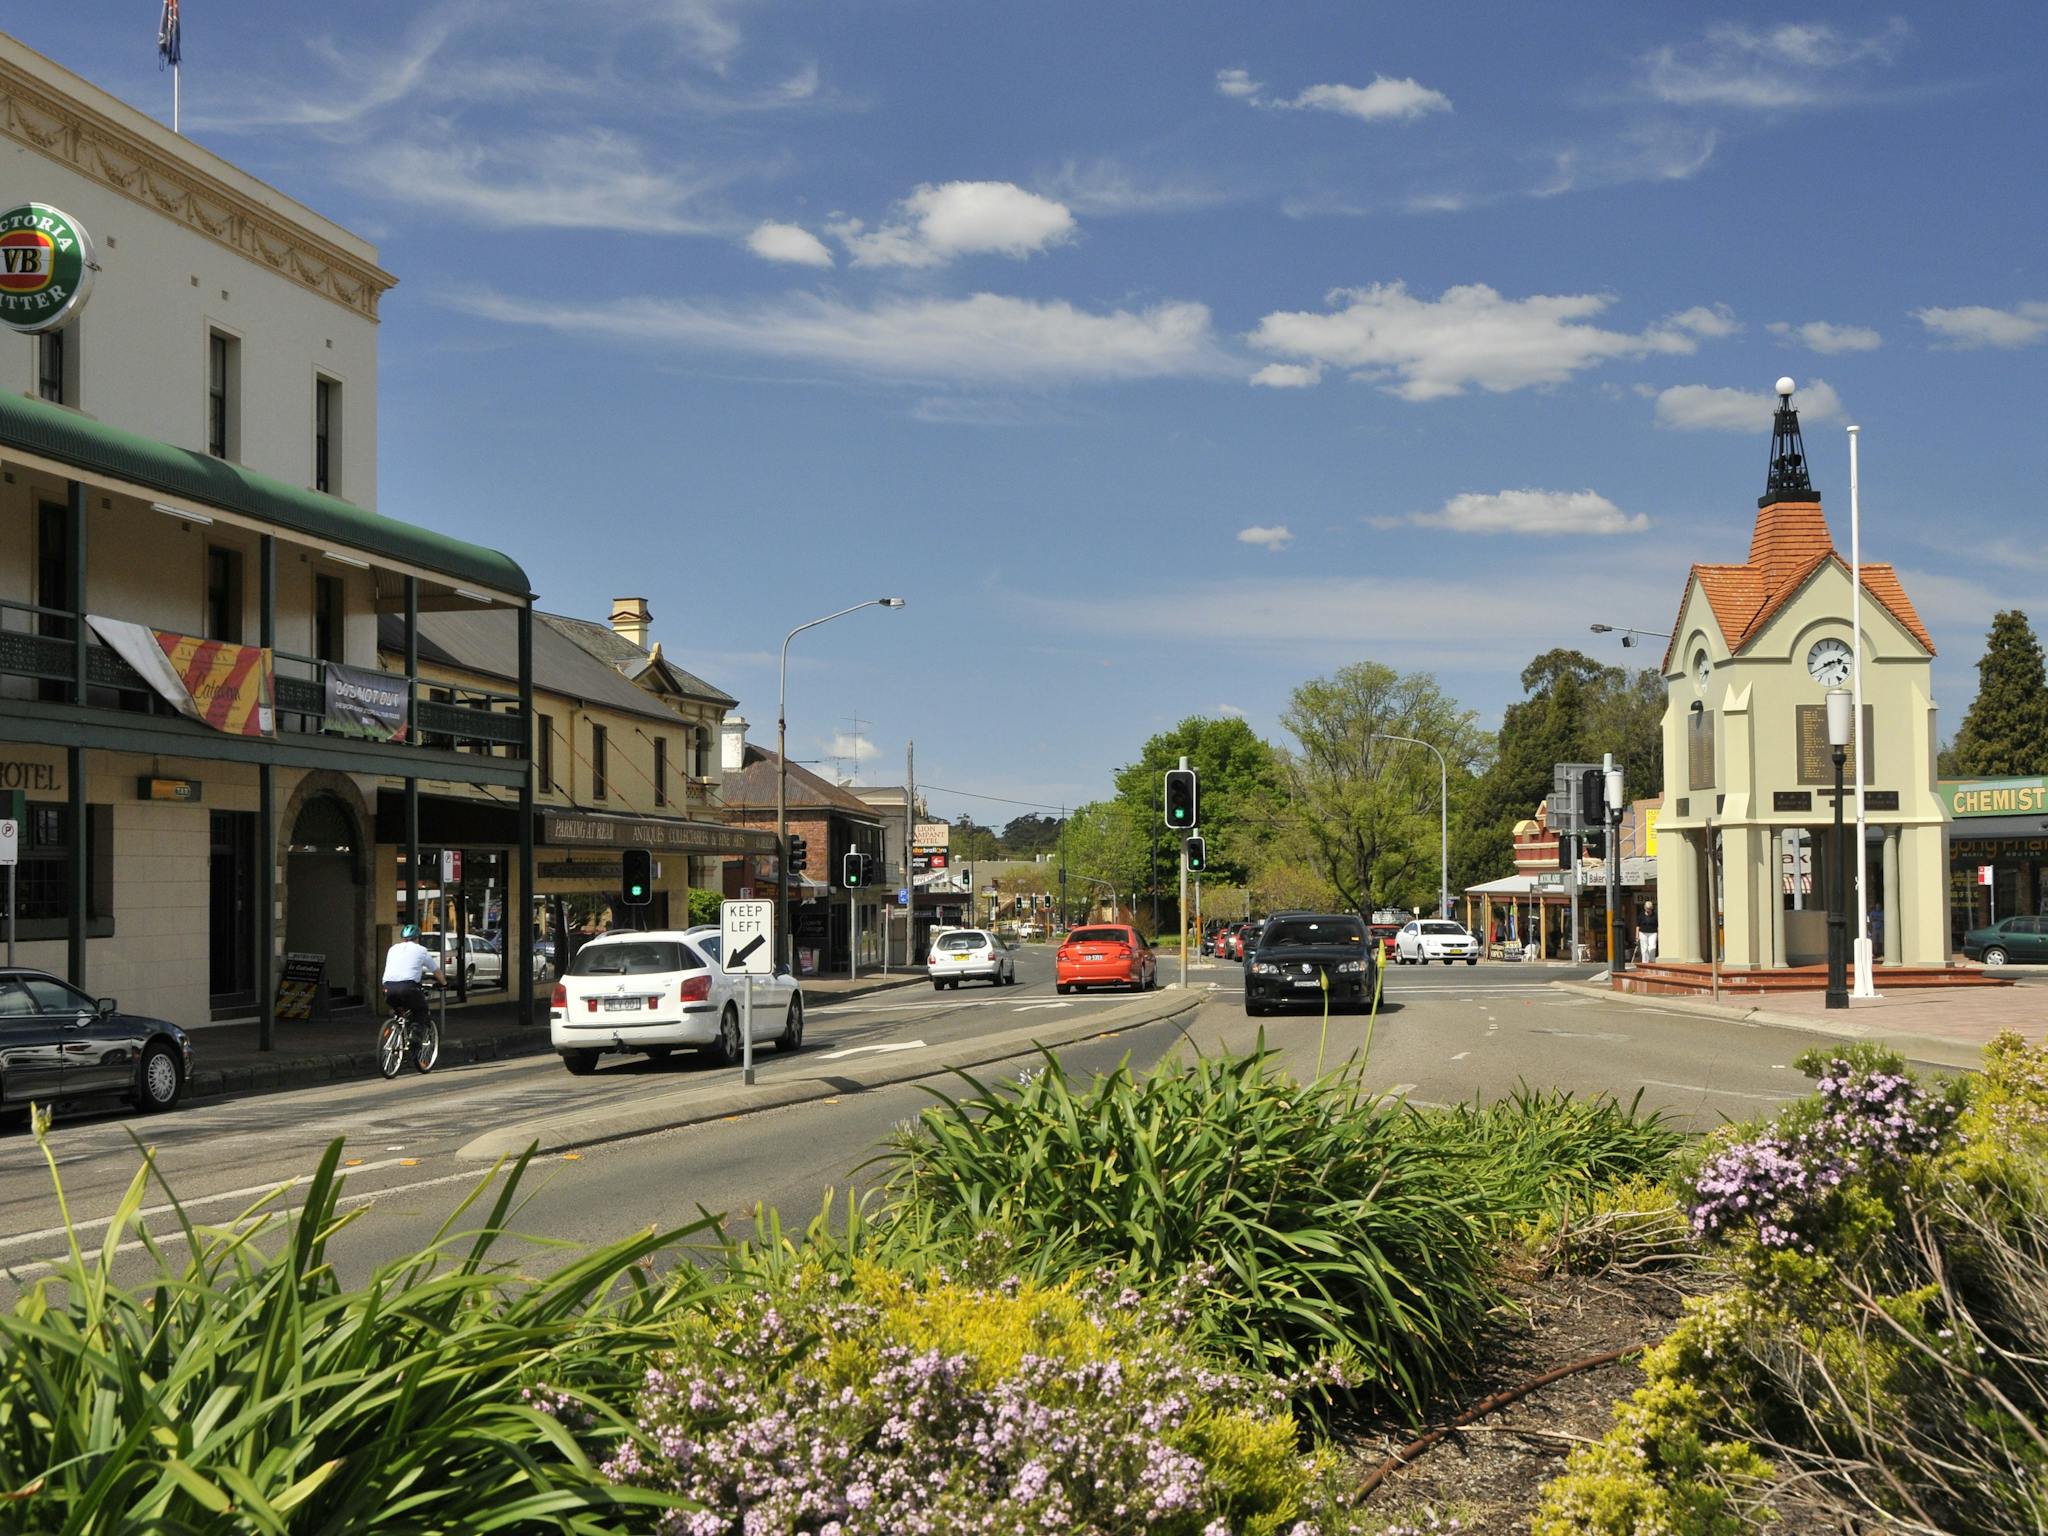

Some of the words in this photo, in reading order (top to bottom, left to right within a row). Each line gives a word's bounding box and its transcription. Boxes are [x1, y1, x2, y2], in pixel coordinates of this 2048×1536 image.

[1, 247, 43, 274] VB
[357, 686, 379, 705] NOT
[379, 691, 399, 708] OUT
[1953, 786, 2047, 814] CHEMIST
[554, 818, 587, 839] PARKING
[586, 821, 597, 839] AT
[597, 822, 614, 841] REAR
[632, 825, 665, 845] ANTIQUES
[1589, 872, 1606, 884] Baker
[730, 905, 763, 917] KEEP
[731, 921, 761, 933] LEFT
